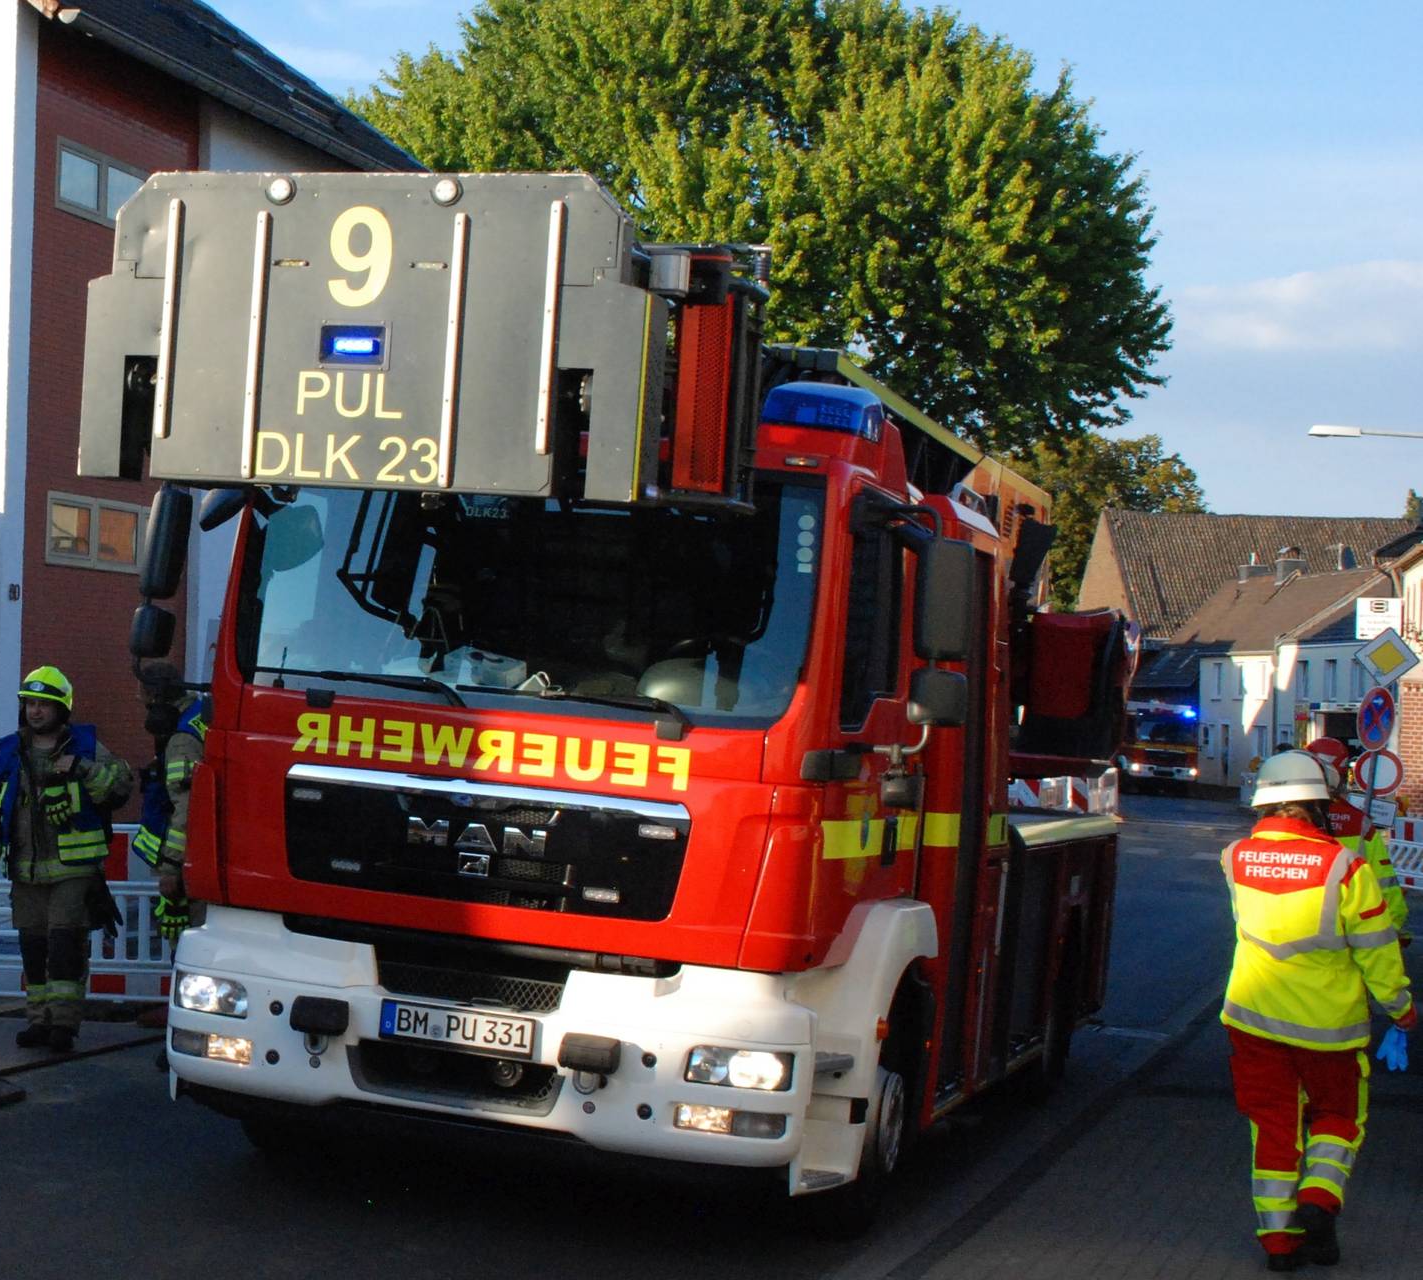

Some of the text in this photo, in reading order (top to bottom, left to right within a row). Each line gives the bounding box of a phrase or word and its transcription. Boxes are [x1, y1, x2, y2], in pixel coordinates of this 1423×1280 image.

[328, 205, 393, 307] 9
[296, 370, 404, 419] PUL
[255, 431, 439, 484] DLK 23
[407, 816, 547, 857] MAN
[1238, 850, 1322, 866] FEUERWEHR
[1245, 865, 1309, 880] FRECHEN
[397, 1008, 429, 1035] BM
[446, 1014, 478, 1042] PU
[483, 1020, 527, 1049] 331
